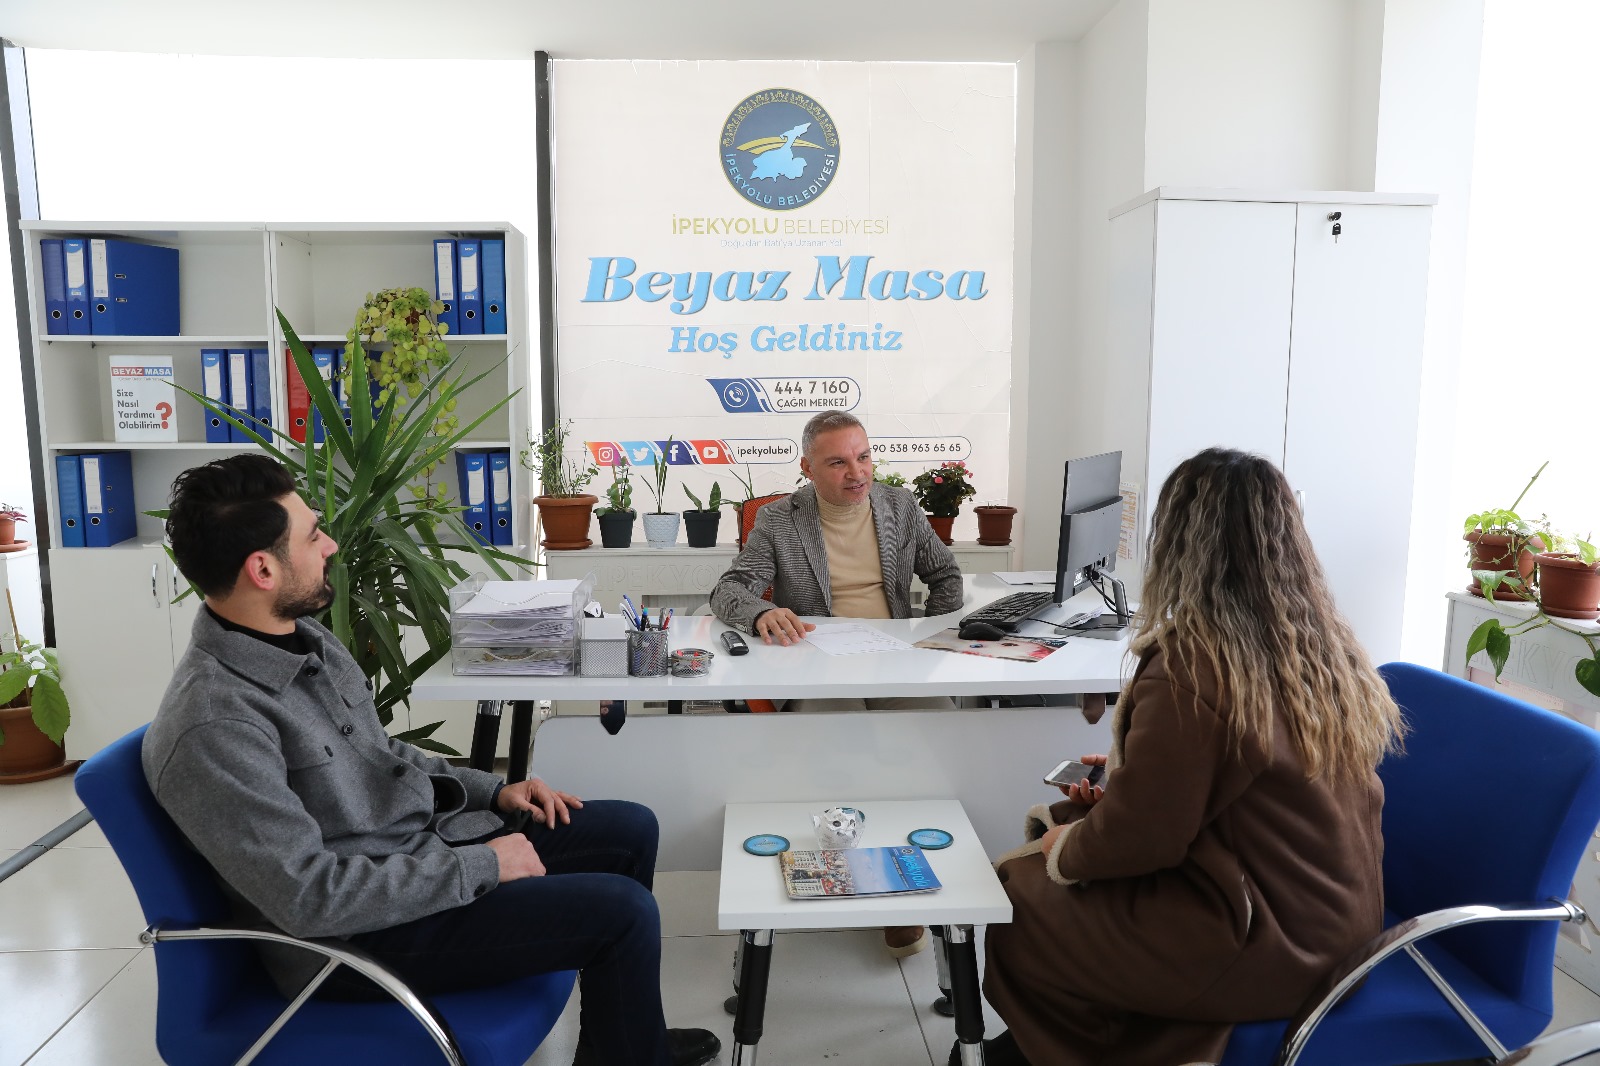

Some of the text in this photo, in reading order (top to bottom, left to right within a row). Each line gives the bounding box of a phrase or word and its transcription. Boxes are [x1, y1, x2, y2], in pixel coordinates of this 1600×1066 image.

[725, 153, 836, 206] İPEKYOLU BELEDİYESİ
[672, 214, 890, 235] İPEKYOLU BELEDİYESİ
[580, 255, 989, 315] Beyaz Masa
[668, 323, 903, 359] Hoş Geldiniz
[112, 368, 172, 376] BEYAZ MASA
[116, 388, 134, 397] Size
[774, 380, 850, 395] 444 7 160
[117, 399, 139, 408] Nasıl
[776, 395, 848, 410] ÇAĞRI MERKEZİ
[118, 409, 155, 419] Yardımcı
[118, 420, 161, 430] Olabilirim
[737, 445, 792, 458] ipekyolubel
[889, 443, 908, 453] 538
[911, 443, 930, 453] 963
[933, 443, 946, 453] 65
[948, 443, 961, 452] 65
